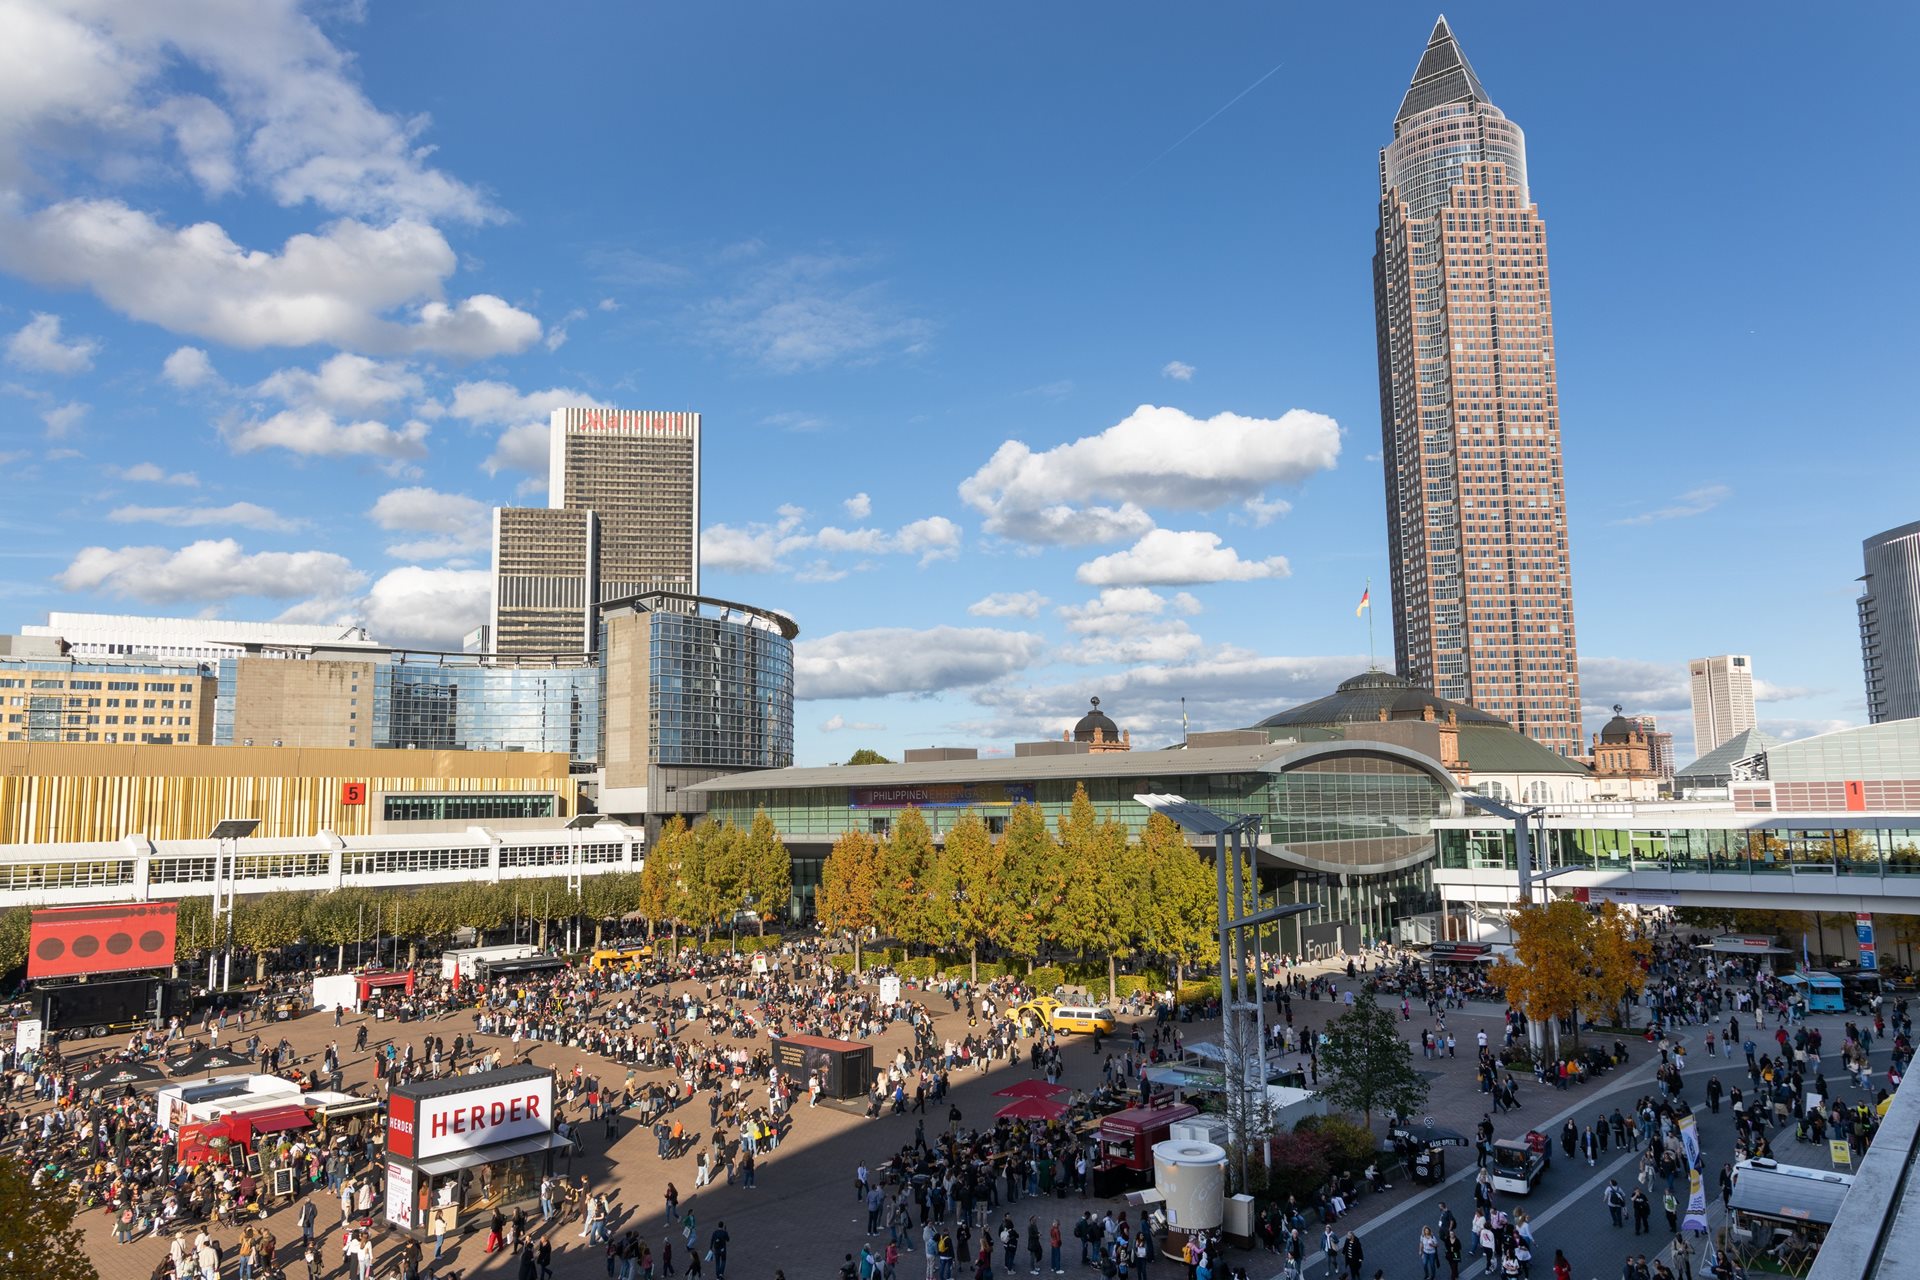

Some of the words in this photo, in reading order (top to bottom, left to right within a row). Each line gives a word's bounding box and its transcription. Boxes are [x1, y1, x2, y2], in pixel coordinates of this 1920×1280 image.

[580, 411, 683, 431] Marriott
[349, 786, 358, 800] 5
[873, 789, 928, 801] PHILIPPINEN
[929, 787, 992, 800] EHRENGAST
[1850, 782, 1857, 795] 1
[432, 1094, 540, 1139] HERDER
[389, 1116, 413, 1135] HERDER
